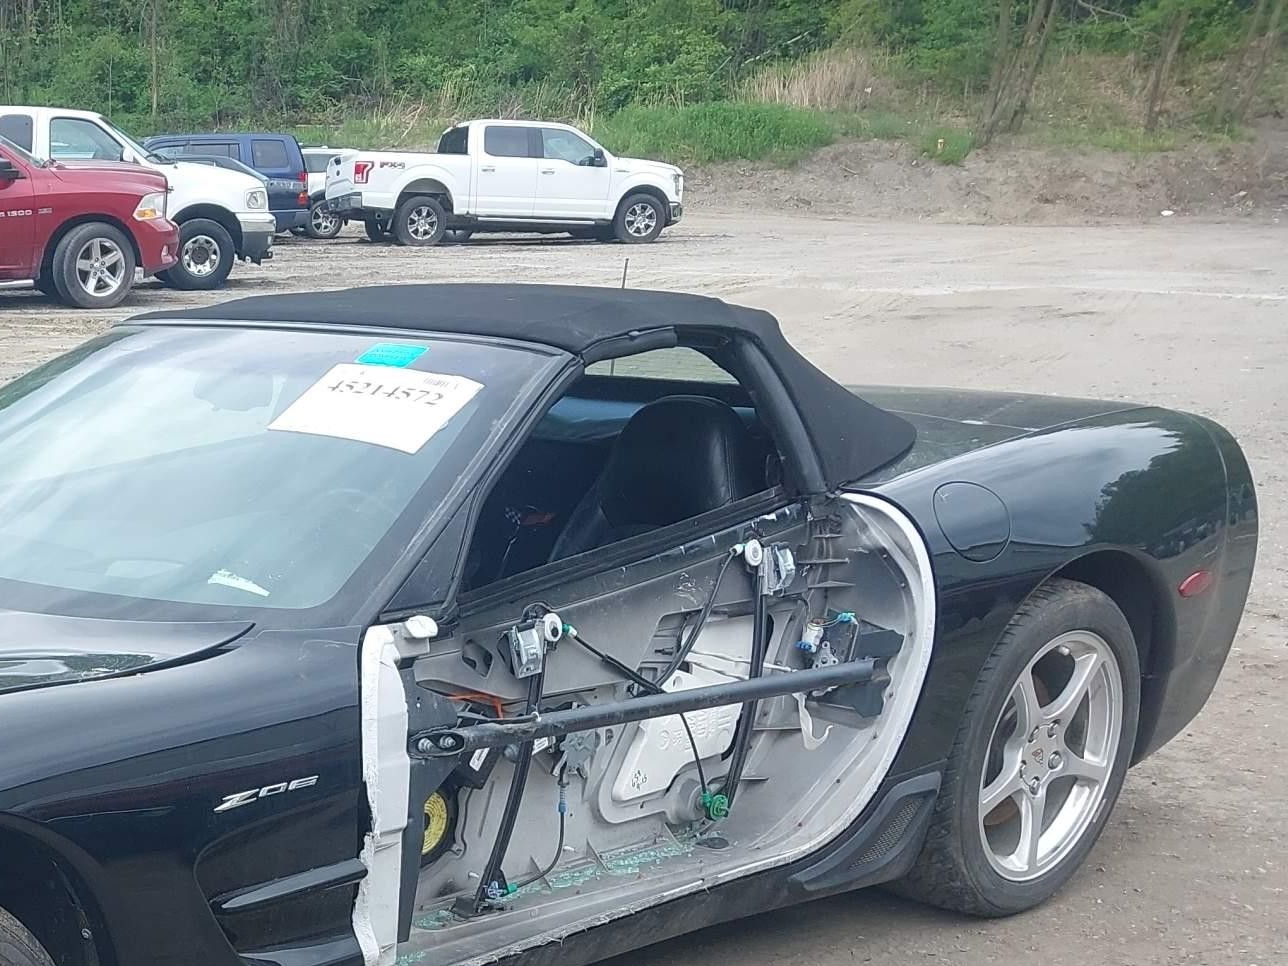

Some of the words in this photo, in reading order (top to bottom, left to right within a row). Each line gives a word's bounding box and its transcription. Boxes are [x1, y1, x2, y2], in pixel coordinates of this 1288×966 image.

[7, 209, 33, 217] 1500
[327, 379, 445, 407] 45214572
[213, 775, 319, 814] Z06
